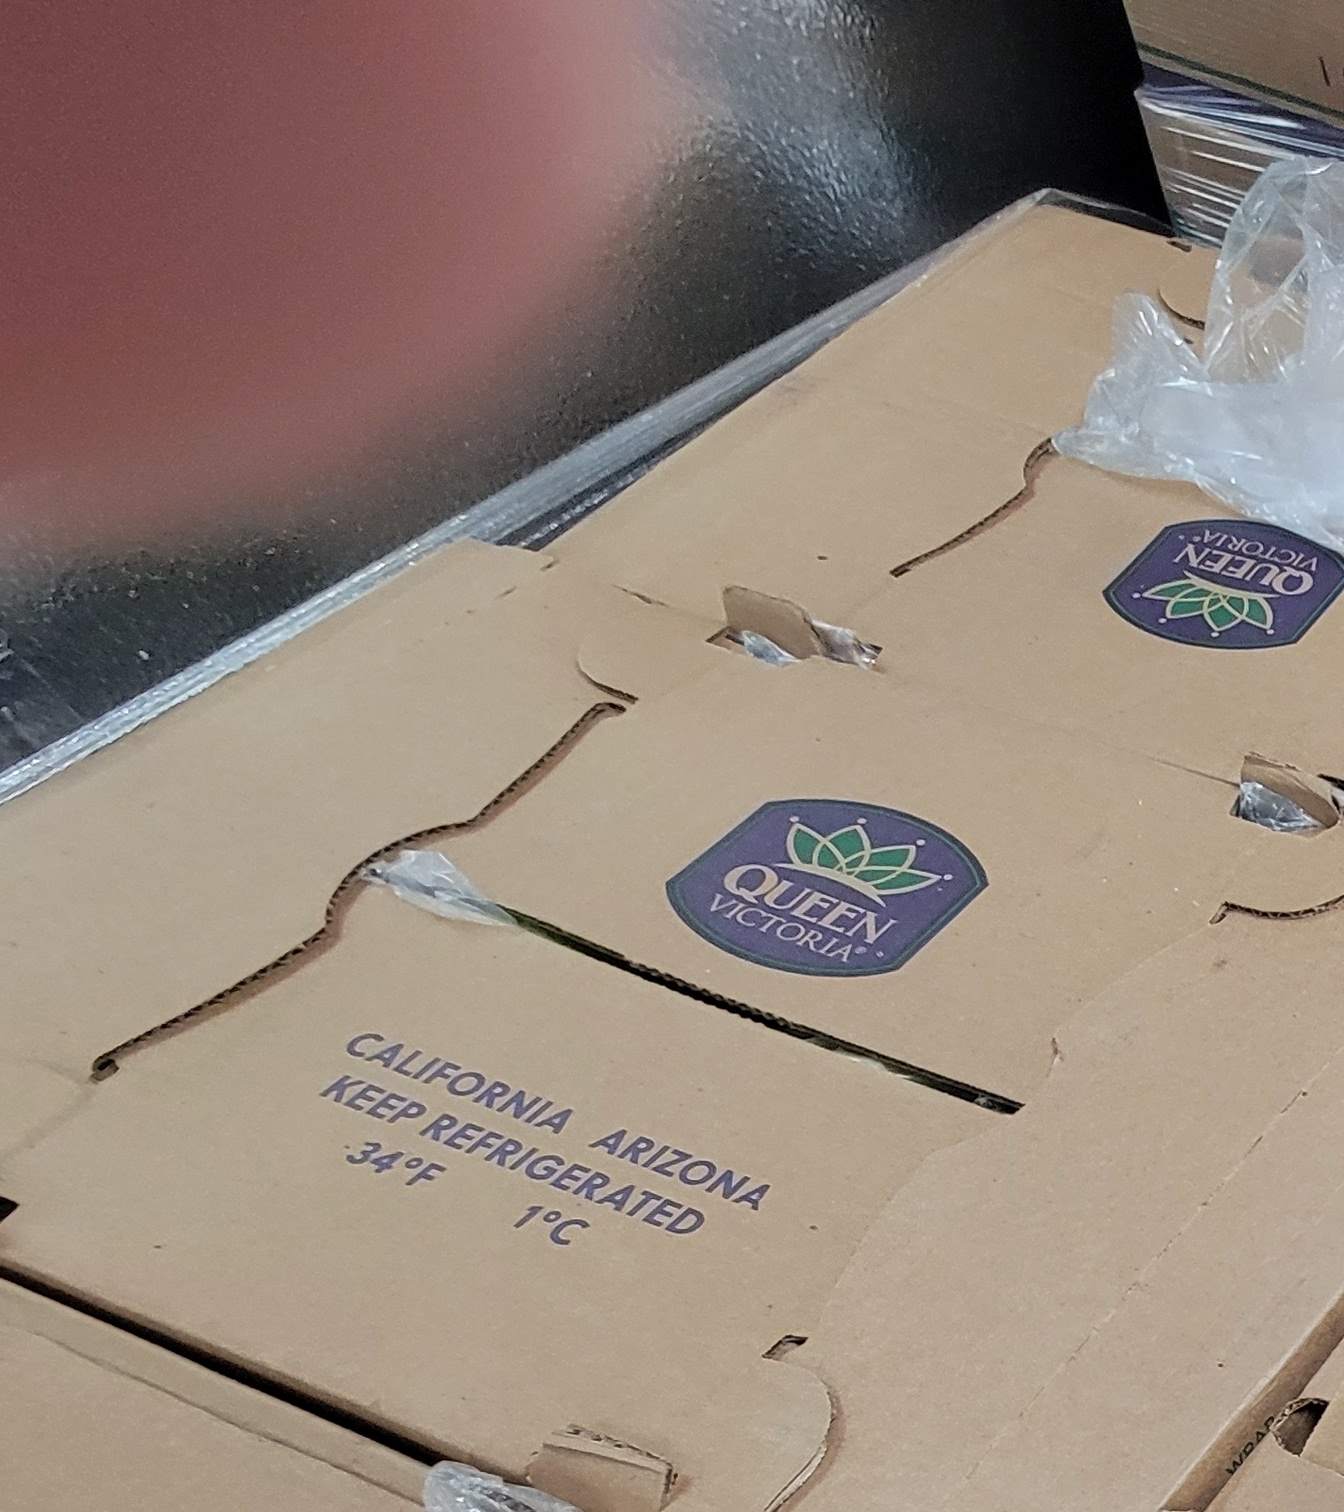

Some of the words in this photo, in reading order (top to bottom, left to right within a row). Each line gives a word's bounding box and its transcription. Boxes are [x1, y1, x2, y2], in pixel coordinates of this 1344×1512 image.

[1172, 542, 1314, 596] QUEEN
[1202, 528, 1319, 572] VICTORIA
[706, 893, 855, 963] VICTORIA
[723, 863, 898, 946] QUEEN
[319, 1074, 428, 1125] KEEP
[418, 1113, 706, 1236] REFRIGERATED
[345, 1031, 575, 1135] CALIFORNIA
[588, 1128, 772, 1211] ARIZONA
[345, 1140, 448, 1187] 34°F
[512, 1204, 592, 1247] 1°C
